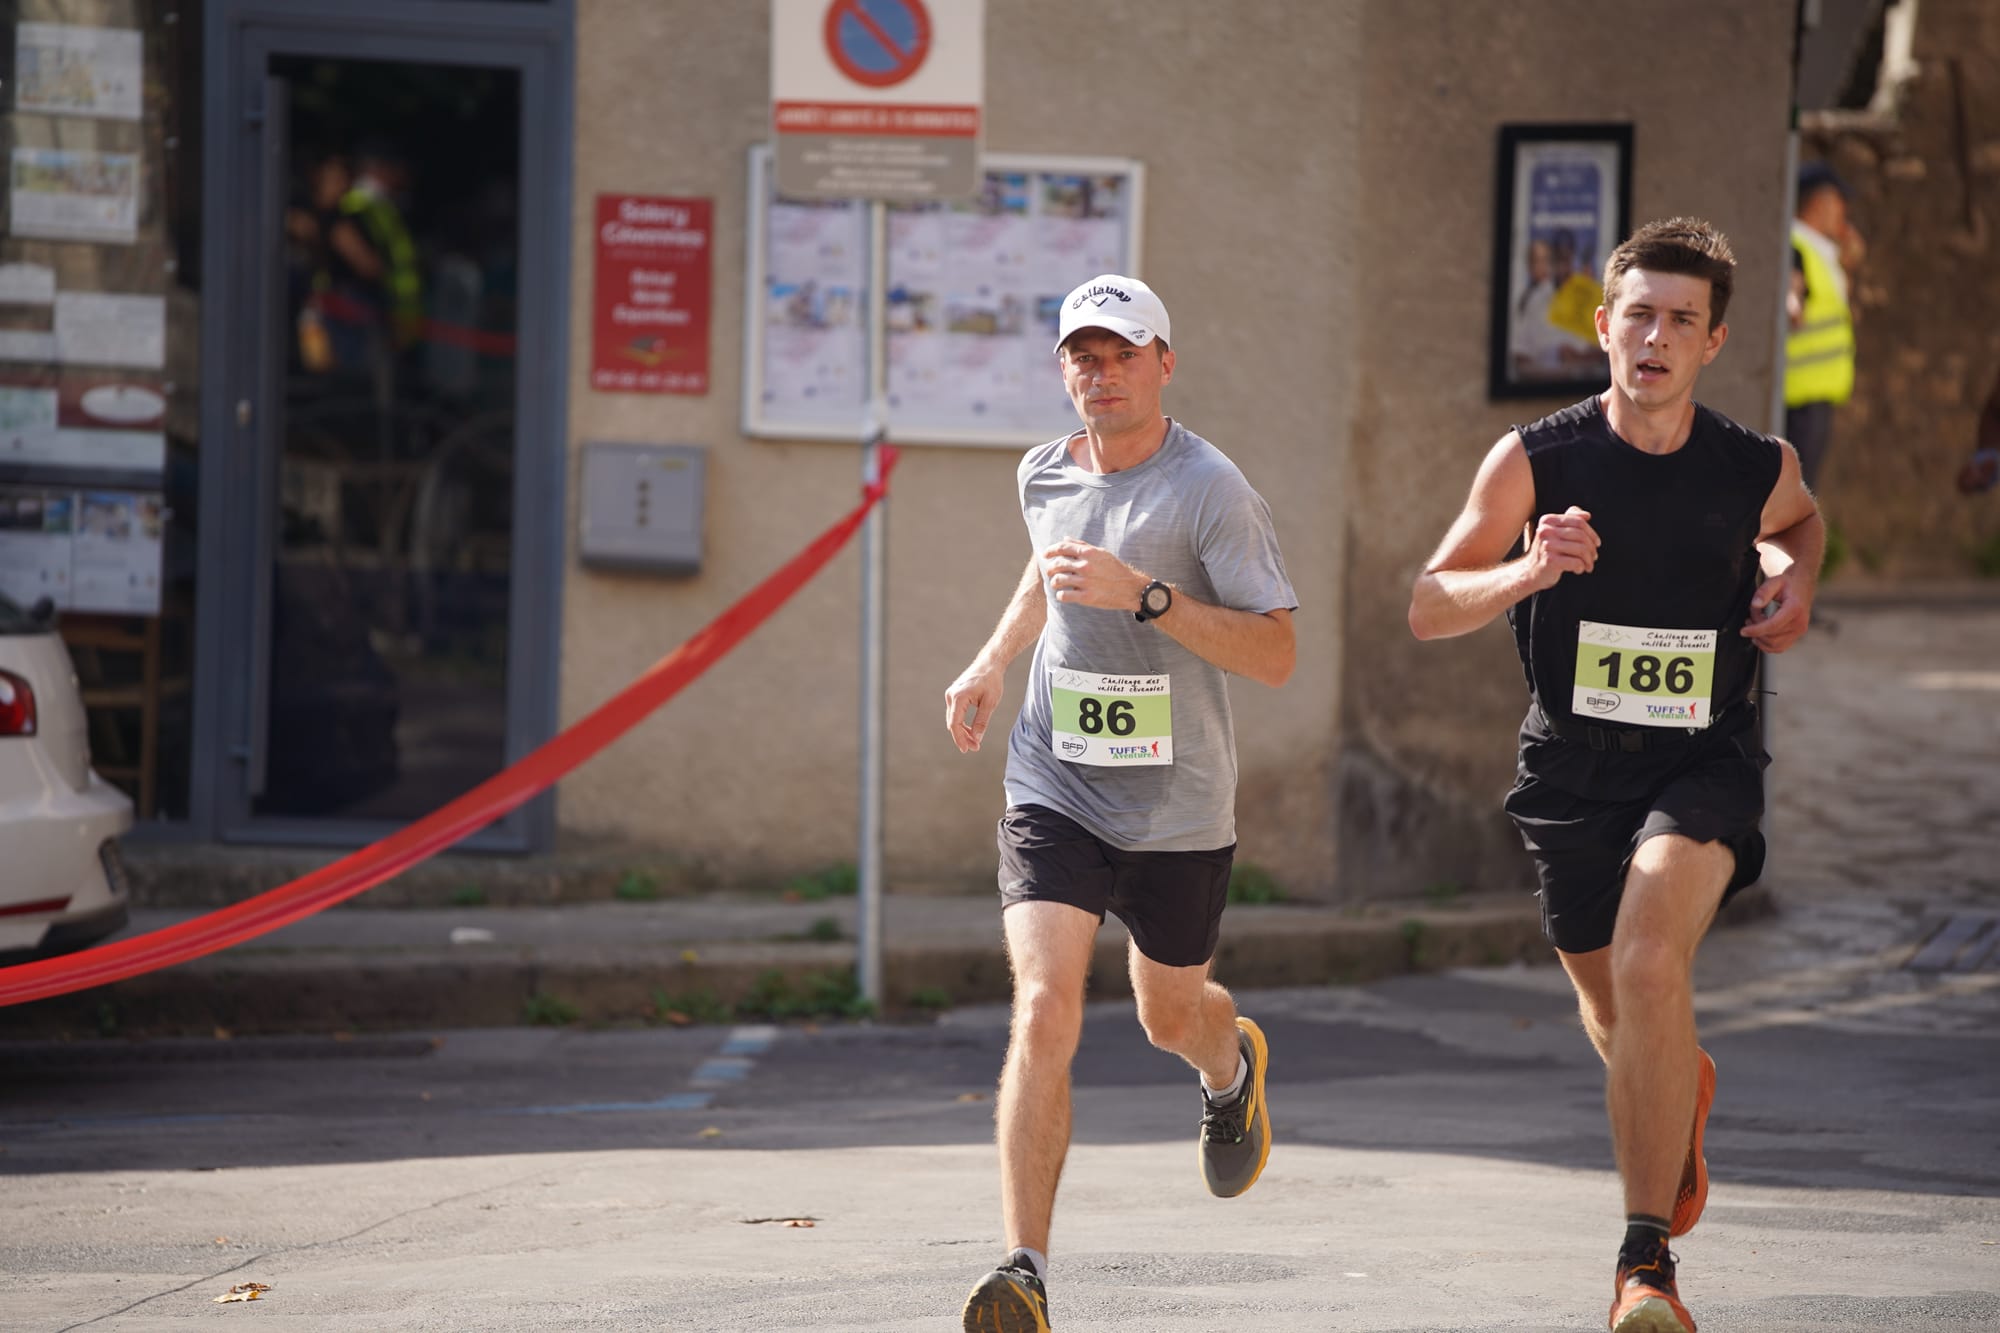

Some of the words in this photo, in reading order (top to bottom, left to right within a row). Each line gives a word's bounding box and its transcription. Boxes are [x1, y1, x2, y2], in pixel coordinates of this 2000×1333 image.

[1073, 286, 1131, 309] Callaway
[1647, 631, 1688, 641] Challenge
[1693, 633, 1707, 641] des
[1598, 651, 1695, 695] 186
[1101, 676, 1141, 687] Challenge
[1586, 696, 1615, 707] BFP
[1645, 704, 1686, 714] TUFF'S
[1078, 697, 1136, 736] 86
[1061, 741, 1084, 750] BFP
[1108, 745, 1148, 755] TUFF'S
[1112, 752, 1152, 760] Aventure
